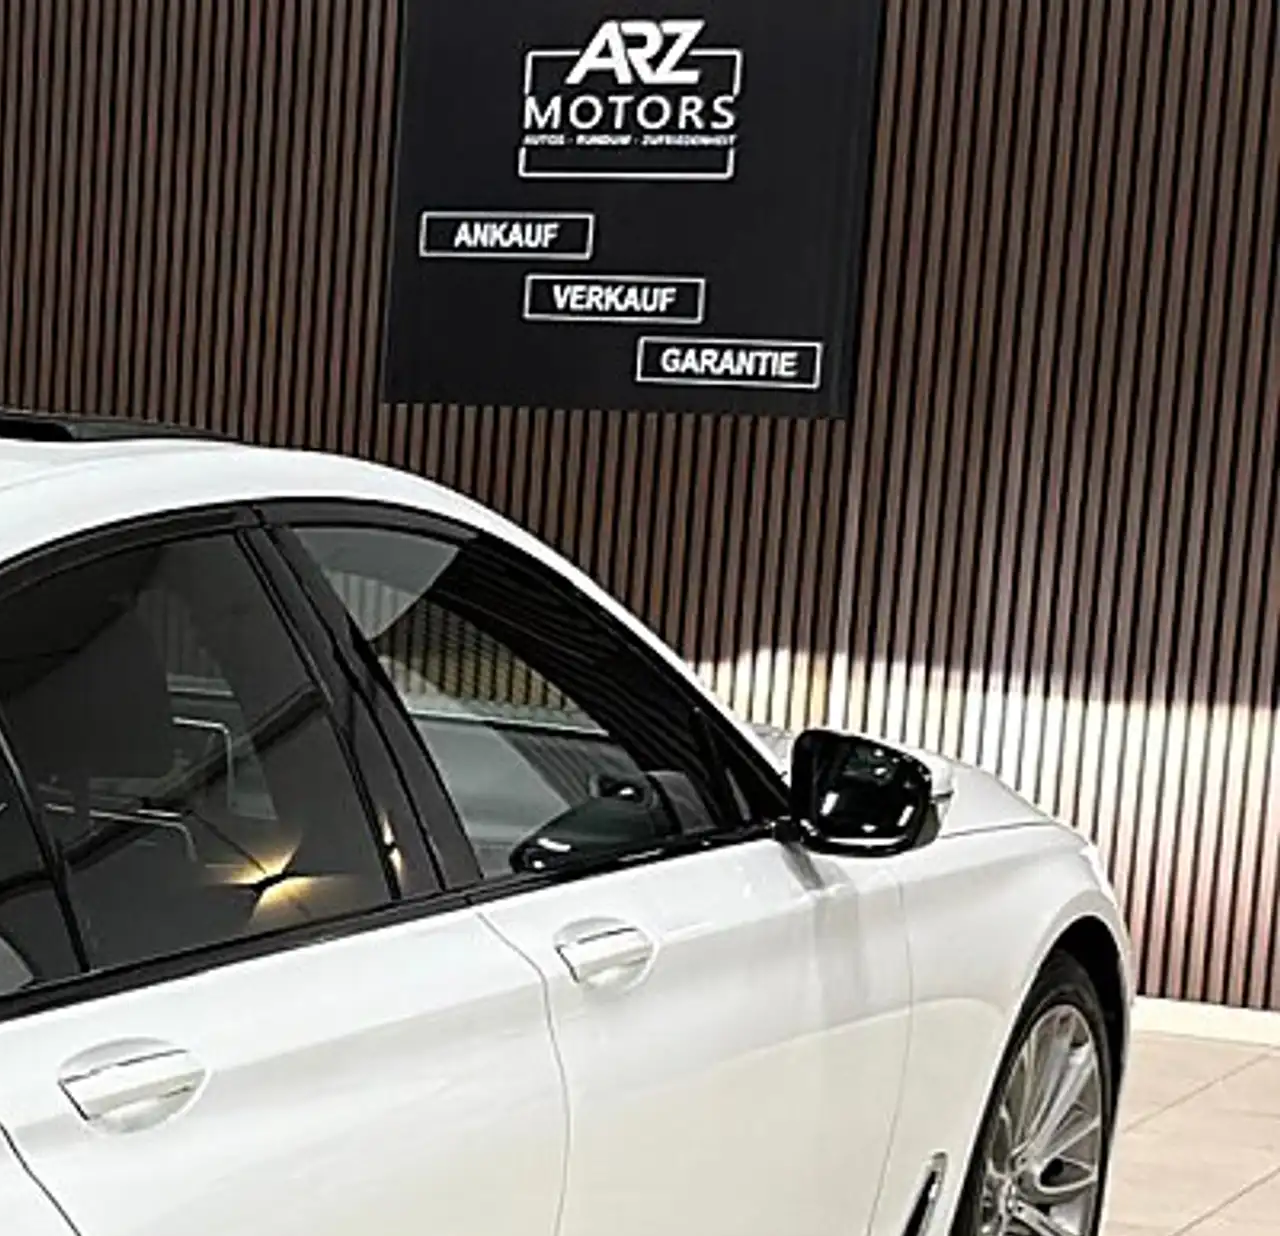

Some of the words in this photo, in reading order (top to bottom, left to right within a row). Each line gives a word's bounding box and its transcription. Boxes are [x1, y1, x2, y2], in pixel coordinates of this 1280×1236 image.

[565, 19, 705, 85] ARZ
[523, 95, 736, 129] MOTORS
[453, 222, 559, 248] ANKAUF
[552, 284, 677, 312] VERKAUF
[661, 347, 798, 377] GARANTIE
